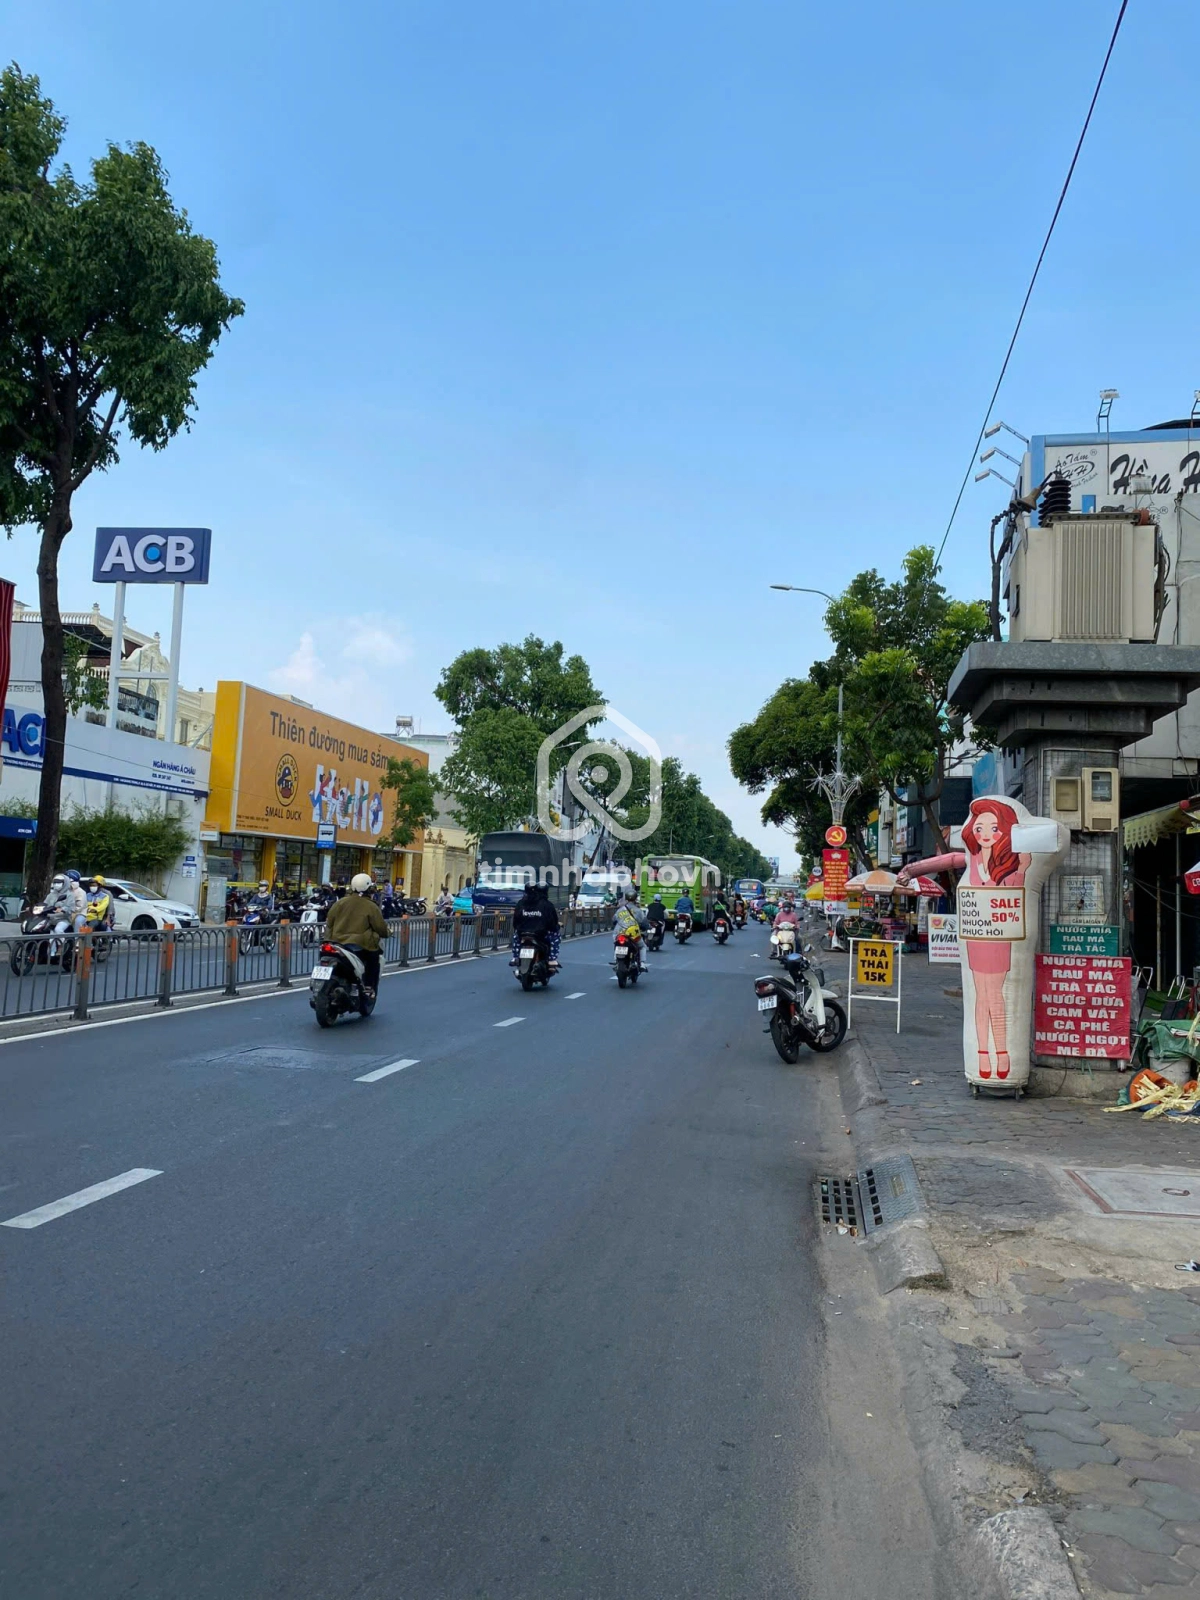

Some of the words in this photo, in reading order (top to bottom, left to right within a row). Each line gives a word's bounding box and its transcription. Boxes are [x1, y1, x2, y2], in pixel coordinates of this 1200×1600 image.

[100, 534, 195, 573] ACB
[2, 708, 47, 758] AC
[270, 711, 305, 745] Thiên
[309, 726, 346, 762] đường
[348, 743, 368, 764] mua
[309, 764, 384, 835] Hello
[265, 806, 284, 819] SMALL
[286, 809, 302, 821] DUCK
[990, 898, 1020, 909] SALE
[991, 912, 1020, 922] 50%
[962, 928, 983, 937] PHỤC
[1087, 935, 1105, 943] MÁ
[860, 959, 889, 969] THÁI
[1043, 955, 1087, 966] NƯỚC
[864, 971, 886, 982] 15K
[1052, 969, 1083, 979] RAU
[1088, 970, 1114, 980] MÁ
[1049, 981, 1080, 992] TRÀ
[1041, 994, 1086, 1005] NƯỚC
[1091, 996, 1124, 1007] DỪA
[1046, 1006, 1082, 1017] CAM
[1053, 1019, 1075, 1030] CÀ
[1080, 1021, 1110, 1032] PHÊ
[1035, 1031, 1080, 1043] NƯỚC
[1085, 1034, 1128, 1046] NGỌT
[1056, 1046, 1080, 1056] ME
